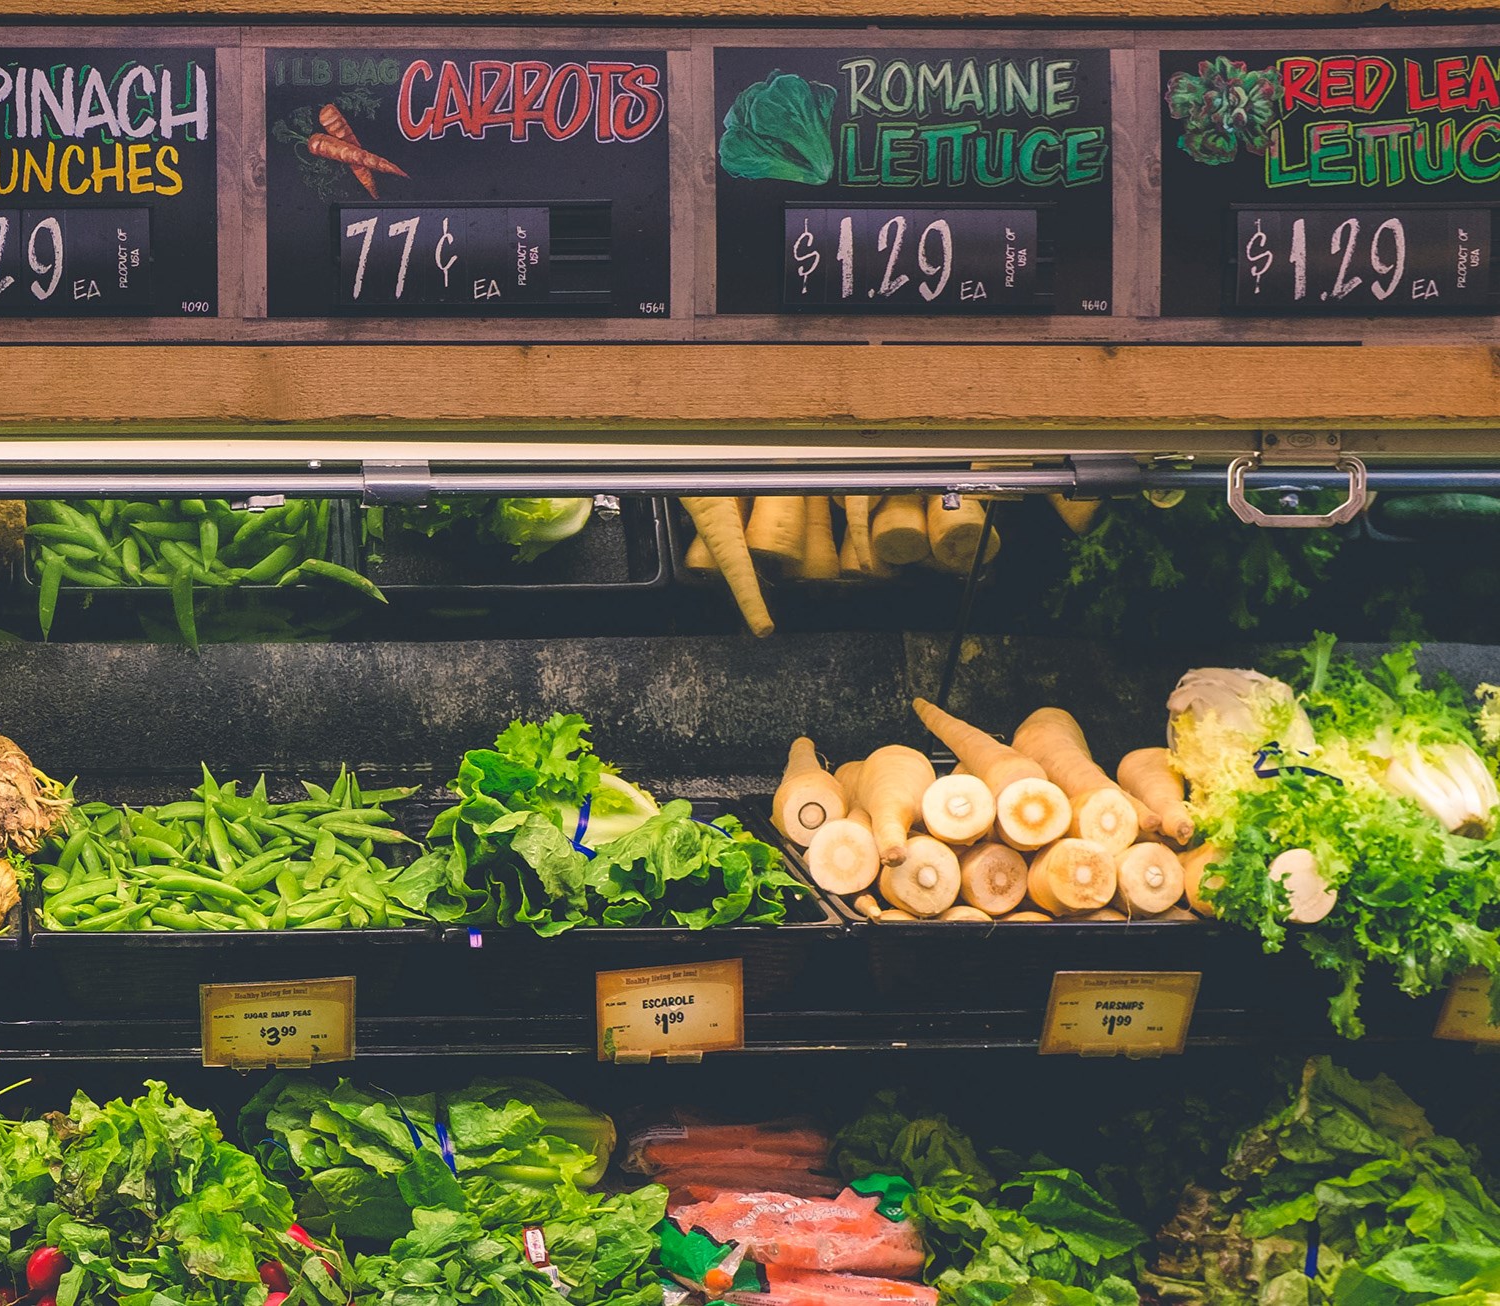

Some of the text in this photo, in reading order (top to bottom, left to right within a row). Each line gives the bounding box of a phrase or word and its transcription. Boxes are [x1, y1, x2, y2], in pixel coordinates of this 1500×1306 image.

[274, 57, 399, 86] 1 LB BAG
[838, 57, 1078, 118] ROMAINE
[1277, 56, 1500, 116] RED LEA
[398, 60, 663, 143] CARROTS
[840, 122, 1107, 187] LETTUCE
[117, 228, 128, 289] PRODUCT OF
[130, 248, 140, 268] USA
[516, 225, 528, 286] PRODUCT OF
[530, 246, 540, 265] USA
[793, 216, 952, 302] $1.29
[1005, 227, 1016, 288] PRODUCT OF
[1018, 248, 1028, 267] USA
[1246, 218, 1406, 301] $1.29
[1456, 228, 1469, 289] PRODUCT OF
[1470, 248, 1481, 267] USA
[73, 279, 101, 301] EA
[473, 279, 501, 299] EA
[960, 281, 987, 301] EA
[1411, 279, 1440, 300] EA
[181, 301, 209, 313] 4090
[639, 302, 665, 313] 4564
[1082, 300, 1108, 311] 4640
[625, 977, 650, 985] Healthy
[651, 973, 671, 982] living
[261, 990, 281, 998] living
[642, 995, 695, 1009] ESCAROLE
[243, 1011, 268, 1020] SUGAR
[271, 1010, 290, 1019] SNAP
[292, 1009, 312, 1017] PEAS
[1095, 1001, 1144, 1010] PARSNIPS
